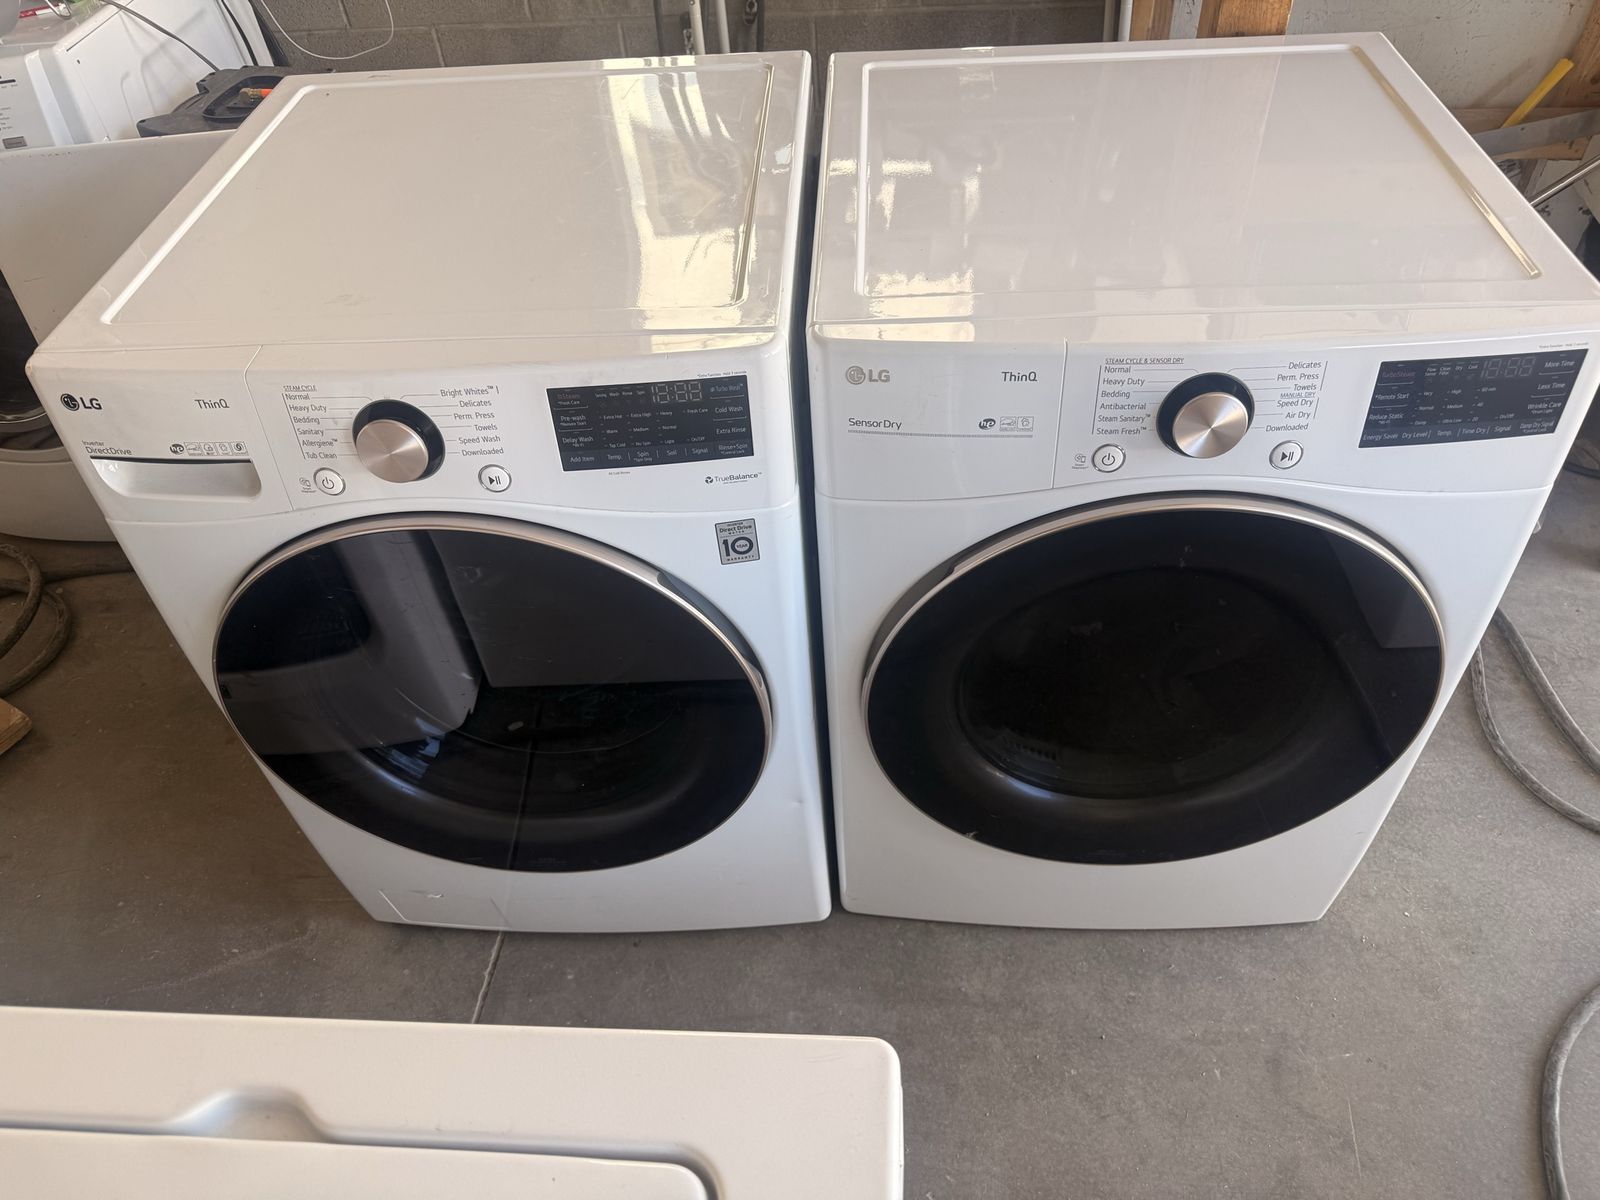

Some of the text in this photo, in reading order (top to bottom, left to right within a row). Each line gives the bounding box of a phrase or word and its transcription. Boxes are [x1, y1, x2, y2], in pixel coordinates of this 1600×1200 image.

[1288, 361, 1322, 370] Delicates
[868, 369, 891, 383] LG
[1001, 371, 1038, 382] ThinQ
[1277, 372, 1319, 382] Perm. Press
[1103, 378, 1145, 387] Heavy Duty
[1293, 383, 1317, 392] Towels
[285, 393, 310, 401] Normal
[440, 388, 463, 399] Bright
[1101, 390, 1131, 400] Bedding
[79, 397, 103, 411] LG
[194, 398, 230, 410] ThinQ
[459, 399, 492, 408] Delicates
[1099, 403, 1147, 411] Antibacterial
[1277, 399, 1314, 409] Speed Dry
[289, 404, 327, 414] Heavy Duty
[453, 411, 495, 421] Perm. Press
[1098, 415, 1118, 423] Steam
[1285, 411, 1311, 420] Air Dry
[293, 416, 320, 425] Bedding
[848, 417, 903, 431] Sensor Dry
[474, 423, 498, 432] Towels
[1265, 423, 1309, 432] Downloaded
[1476, 427, 1486, 435] Dry
[297, 428, 325, 437] Sanitary
[458, 435, 501, 445] Speed Wash
[562, 437, 578, 445] Delay
[1363, 434, 1383, 442] Energy
[305, 452, 338, 460] Tub Clean
[461, 447, 504, 457] Downloaded
[722, 536, 754, 557] 10
